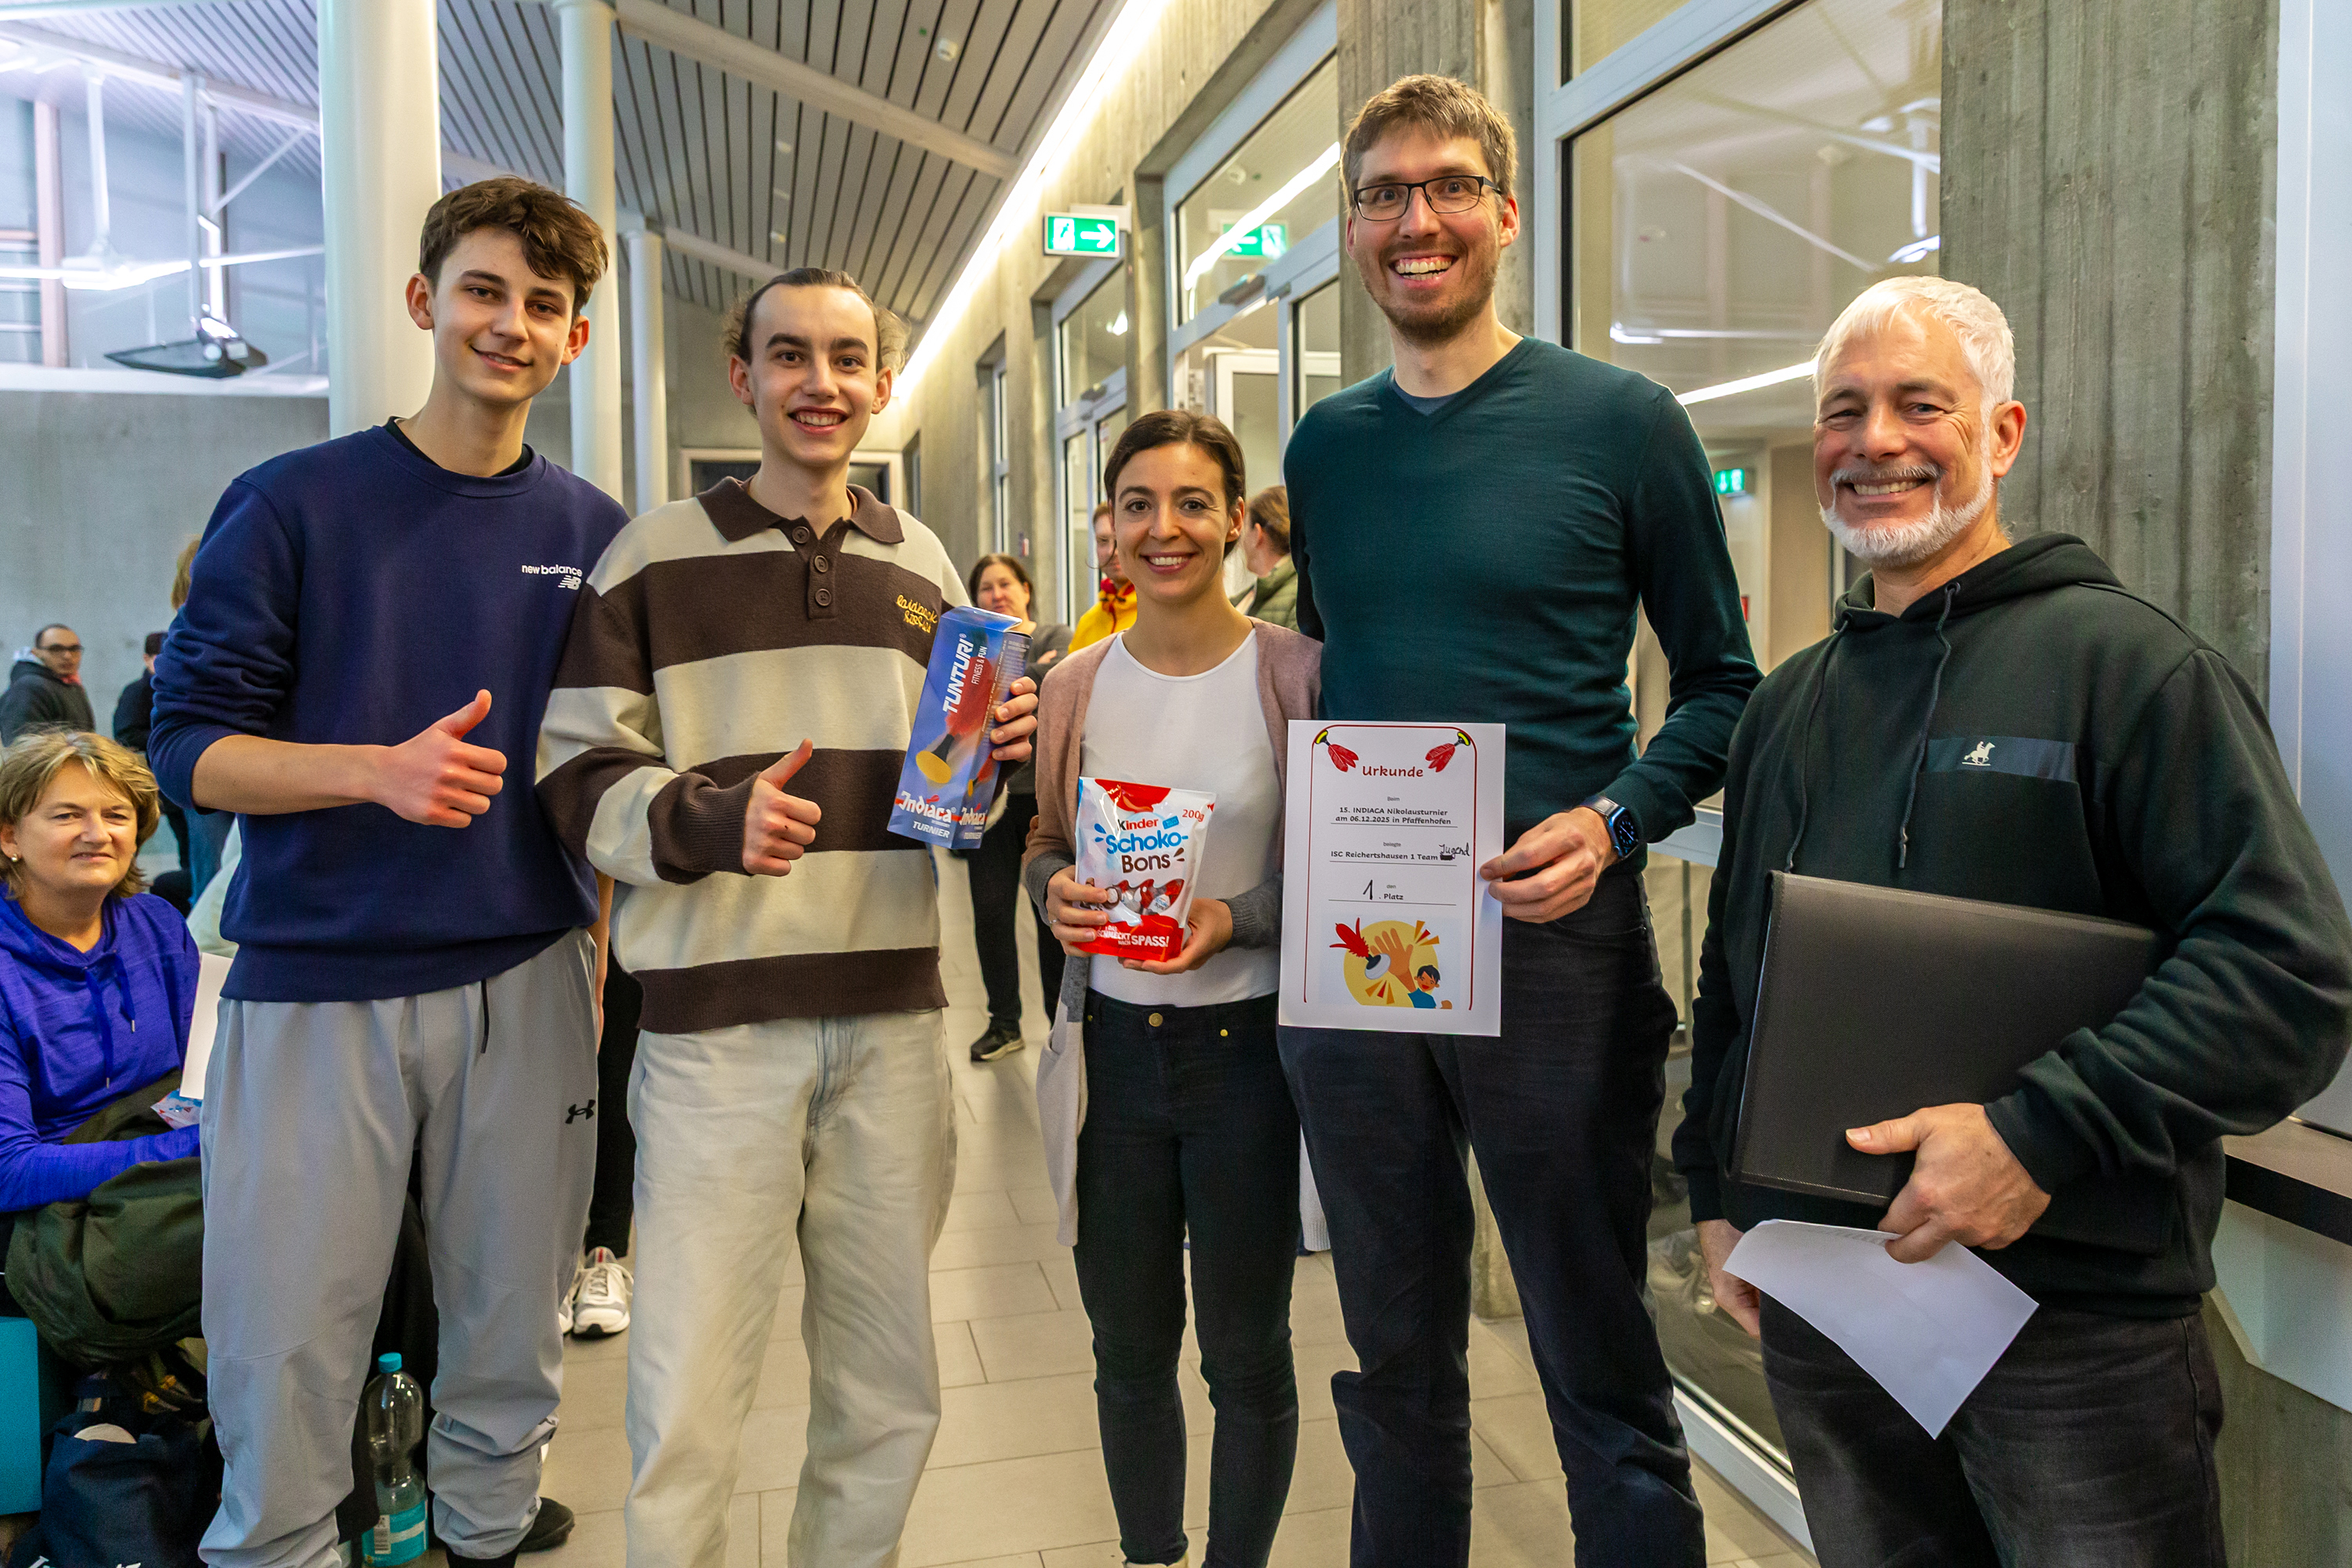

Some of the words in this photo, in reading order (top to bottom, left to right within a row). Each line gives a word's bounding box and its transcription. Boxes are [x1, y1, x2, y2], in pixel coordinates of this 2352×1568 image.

[521, 564, 540, 575] new
[541, 564, 583, 577] balance
[977, 645, 988, 659] FUN
[971, 663, 984, 685] FITNESS
[1363, 765, 1424, 778] Urkunde
[1182, 809, 1205, 822] 200g
[913, 820, 950, 839] TURNIER
[1105, 829, 1189, 855] Schoko-
[1345, 851, 1408, 860] Reichertshausen
[1439, 842, 1470, 858] Jugend
[1121, 854, 1171, 873] Bons
[1363, 879, 1373, 900] 1
[1131, 935, 1170, 948] SPASS!
